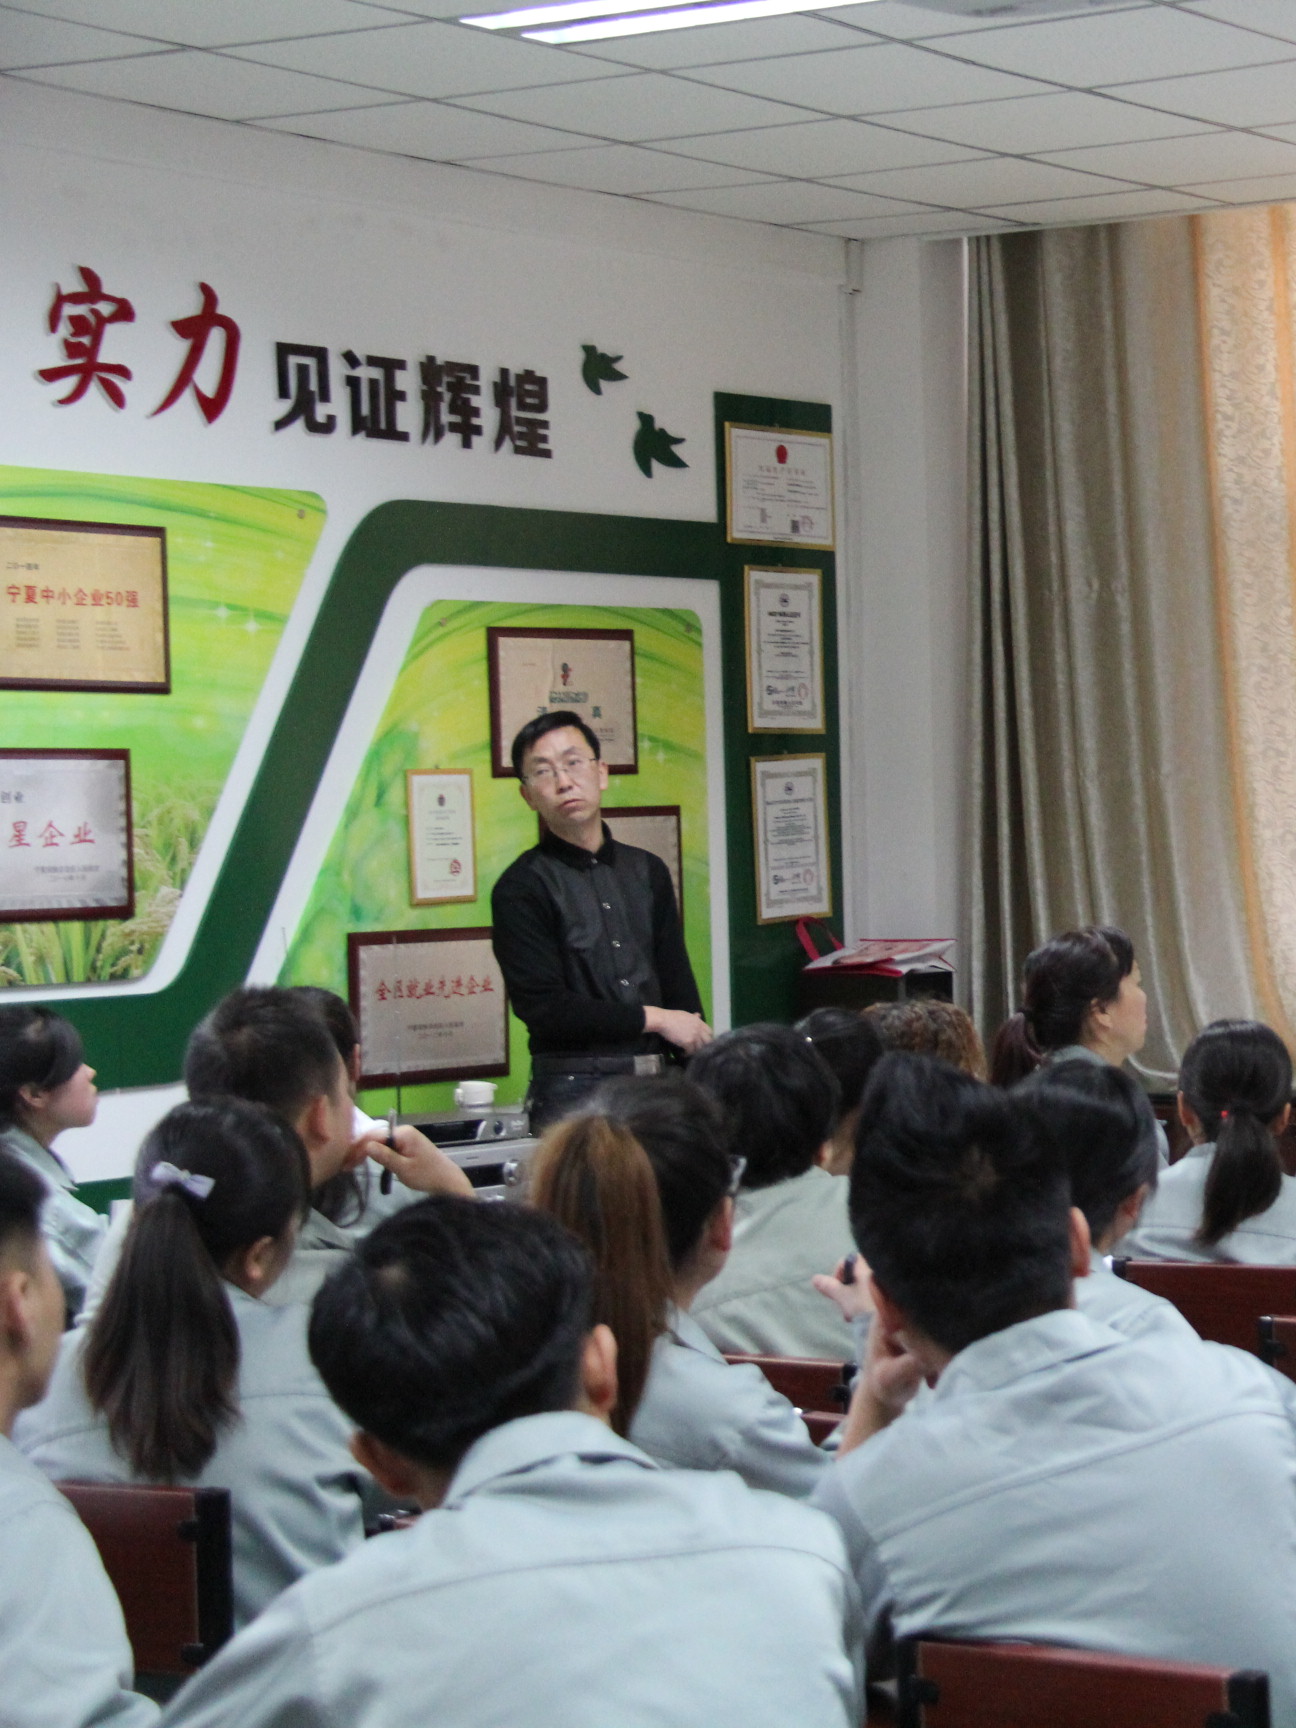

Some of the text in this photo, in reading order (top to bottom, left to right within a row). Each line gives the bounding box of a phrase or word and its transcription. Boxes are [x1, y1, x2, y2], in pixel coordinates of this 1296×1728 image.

[38, 264, 553, 460] 实力 见证辉煌
[6, 584, 140, 608] 宁夏中小企业50强
[8, 820, 96, 848] 星企业
